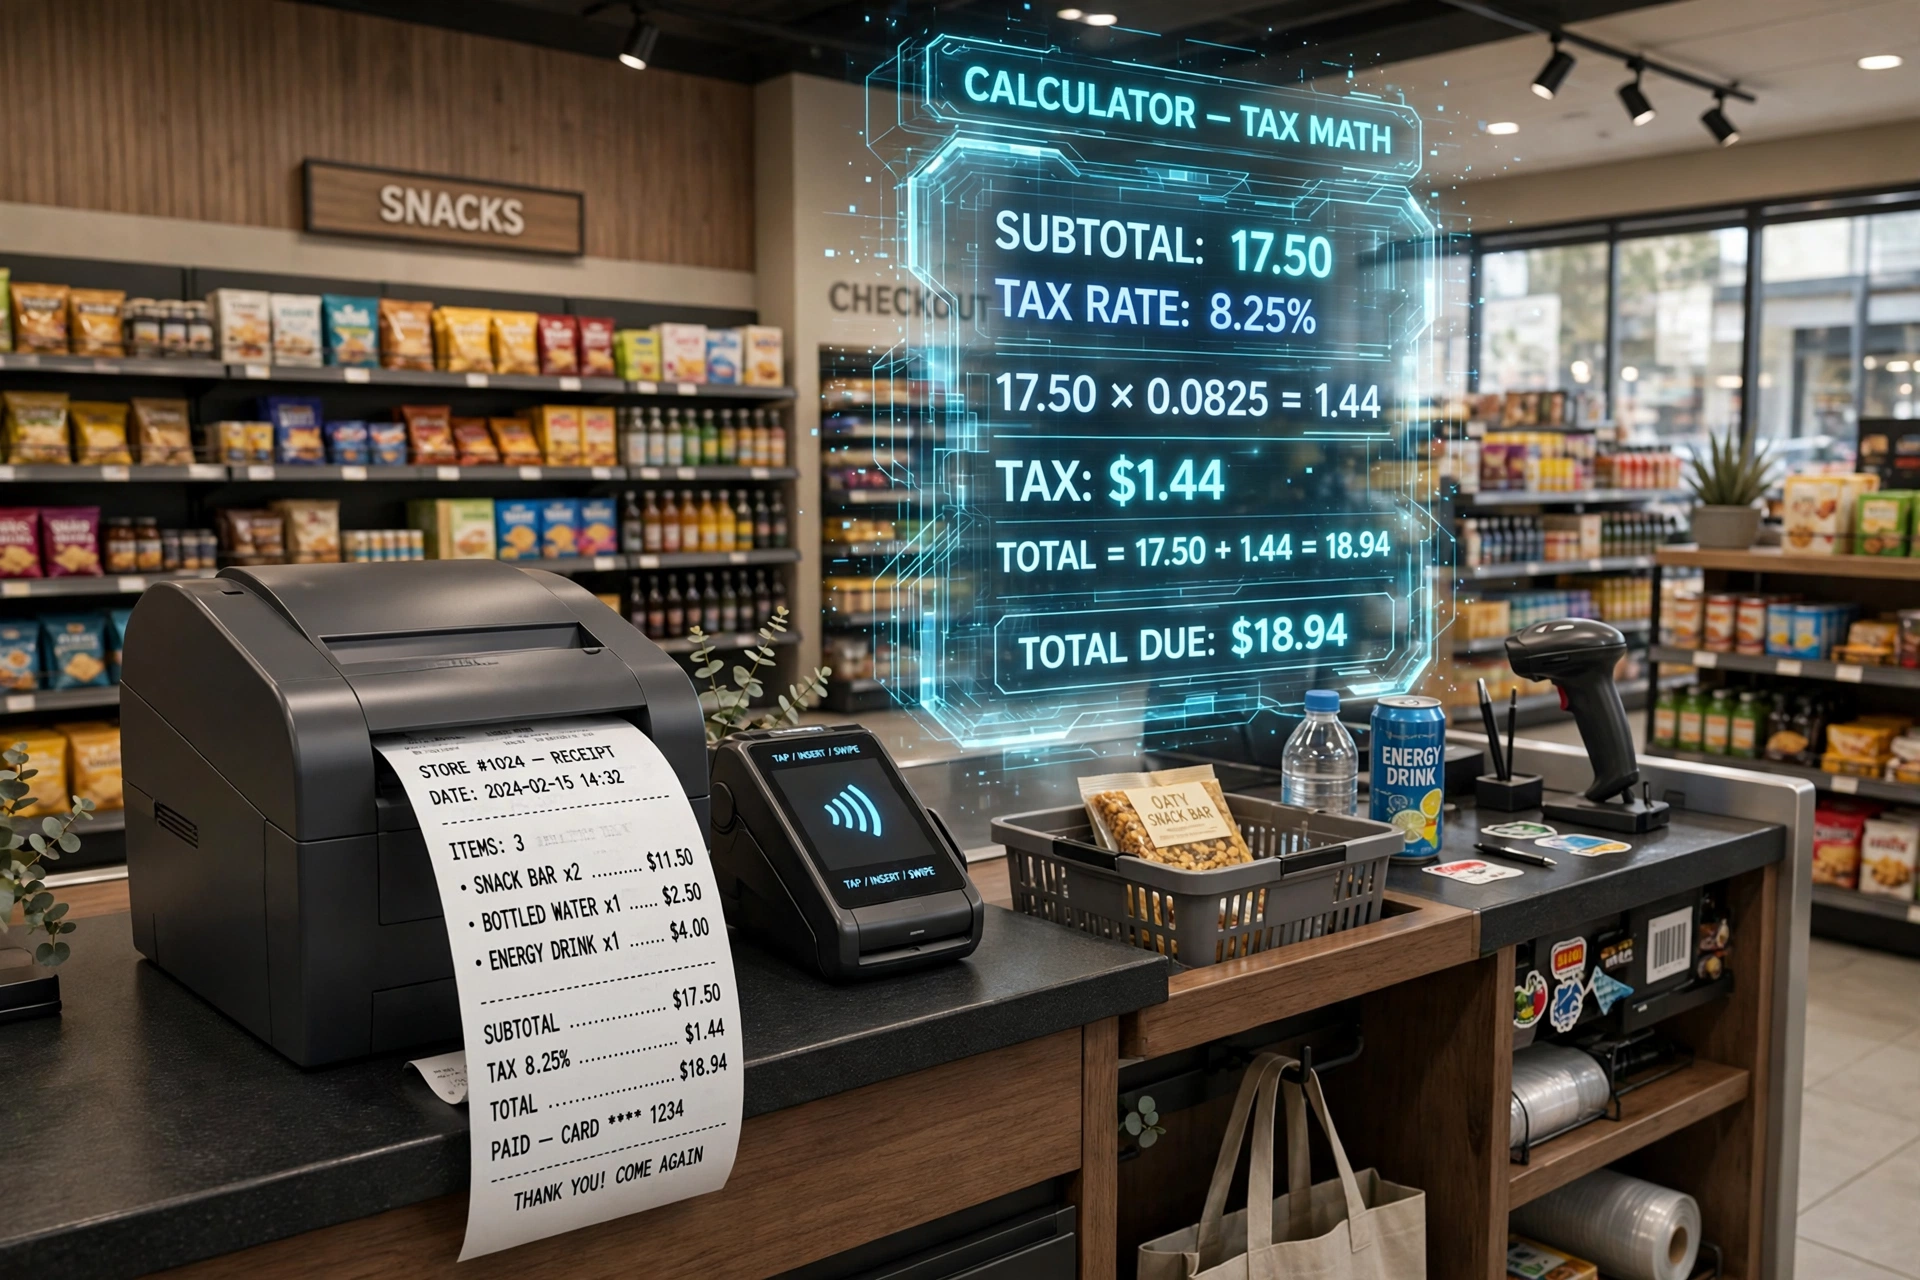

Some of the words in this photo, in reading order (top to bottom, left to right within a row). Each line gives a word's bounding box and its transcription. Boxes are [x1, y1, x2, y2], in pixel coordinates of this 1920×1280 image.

[964, 66, 1196, 130] CALCULATOR
[1240, 104, 1300, 143] TAX
[1309, 117, 1392, 154] MATH
[380, 185, 525, 235] SNACKS
[995, 209, 1204, 265] SUBTOTAL:
[1231, 229, 1332, 278] 17.50
[828, 281, 992, 322] CHECKOUT
[995, 278, 1073, 322] TAX
[1086, 284, 1190, 328] RATE:
[1209, 292, 1316, 335] 8.25%
[996, 372, 1097, 413] 17.50
[1147, 377, 1268, 416] 0.0825
[1314, 382, 1381, 419] 1.44
[995, 459, 1092, 502] TAX:
[1109, 454, 1225, 506] $1.44
[996, 540, 1097, 573] TOTAL
[1135, 535, 1207, 567] 17.50
[1214, 542, 1231, 559] +
[1240, 533, 1293, 563] 1.44
[1325, 530, 1391, 560] 18.94
[1018, 631, 1128, 671] TOTAL
[1140, 625, 1215, 662] DUE:
[1231, 612, 1348, 659] $18.94
[419, 760, 470, 779] STORE
[477, 755, 525, 772] #1024
[550, 745, 616, 764] RECEIPT
[772, 753, 790, 763] TAP
[797, 749, 826, 760] INSERT
[833, 744, 860, 756] SWIPE
[1382, 745, 1441, 767] ENERGY
[1386, 767, 1436, 786] DRINK
[429, 786, 478, 805] DATE:
[485, 775, 575, 799] 2024-02-15
[580, 769, 625, 788] 14:32
[1151, 793, 1189, 810] OATY
[1147, 809, 1188, 827] SNACK
[1187, 806, 1214, 820] BAR
[449, 836, 505, 861] ITEMS:
[515, 834, 525, 851] 3
[474, 870, 523, 895] SNACK
[527, 865, 557, 887] BAR
[563, 863, 582, 881] x2
[646, 848, 694, 872] $11.50
[843, 878, 861, 890] TAP
[870, 871, 900, 886] INSERT
[908, 866, 936, 879] SWIPE
[482, 905, 546, 933] BOTTLED
[550, 897, 599, 922] WATER
[604, 894, 621, 914] x1
[662, 882, 702, 907] $2.50
[489, 942, 544, 971] ENERGY
[551, 936, 598, 960] DRINK
[603, 931, 620, 951] x1
[670, 917, 710, 942] $4.00
[484, 1013, 560, 1044] SUBTOTAL
[672, 983, 721, 1010] $17.50
[487, 1058, 517, 1083] TAX
[525, 1049, 571, 1075] 8.25%
[685, 1018, 725, 1045] $1.44
[490, 1093, 538, 1122] TOTAL
[680, 1053, 727, 1081] $18.94
[491, 1134, 531, 1161] PAID
[561, 1118, 599, 1145] CARD
[650, 1099, 684, 1124] 1234
[514, 1182, 563, 1211] THANK
[571, 1171, 606, 1197] YOU!
[615, 1159, 652, 1185] COME
[659, 1146, 704, 1175] AGAIN
